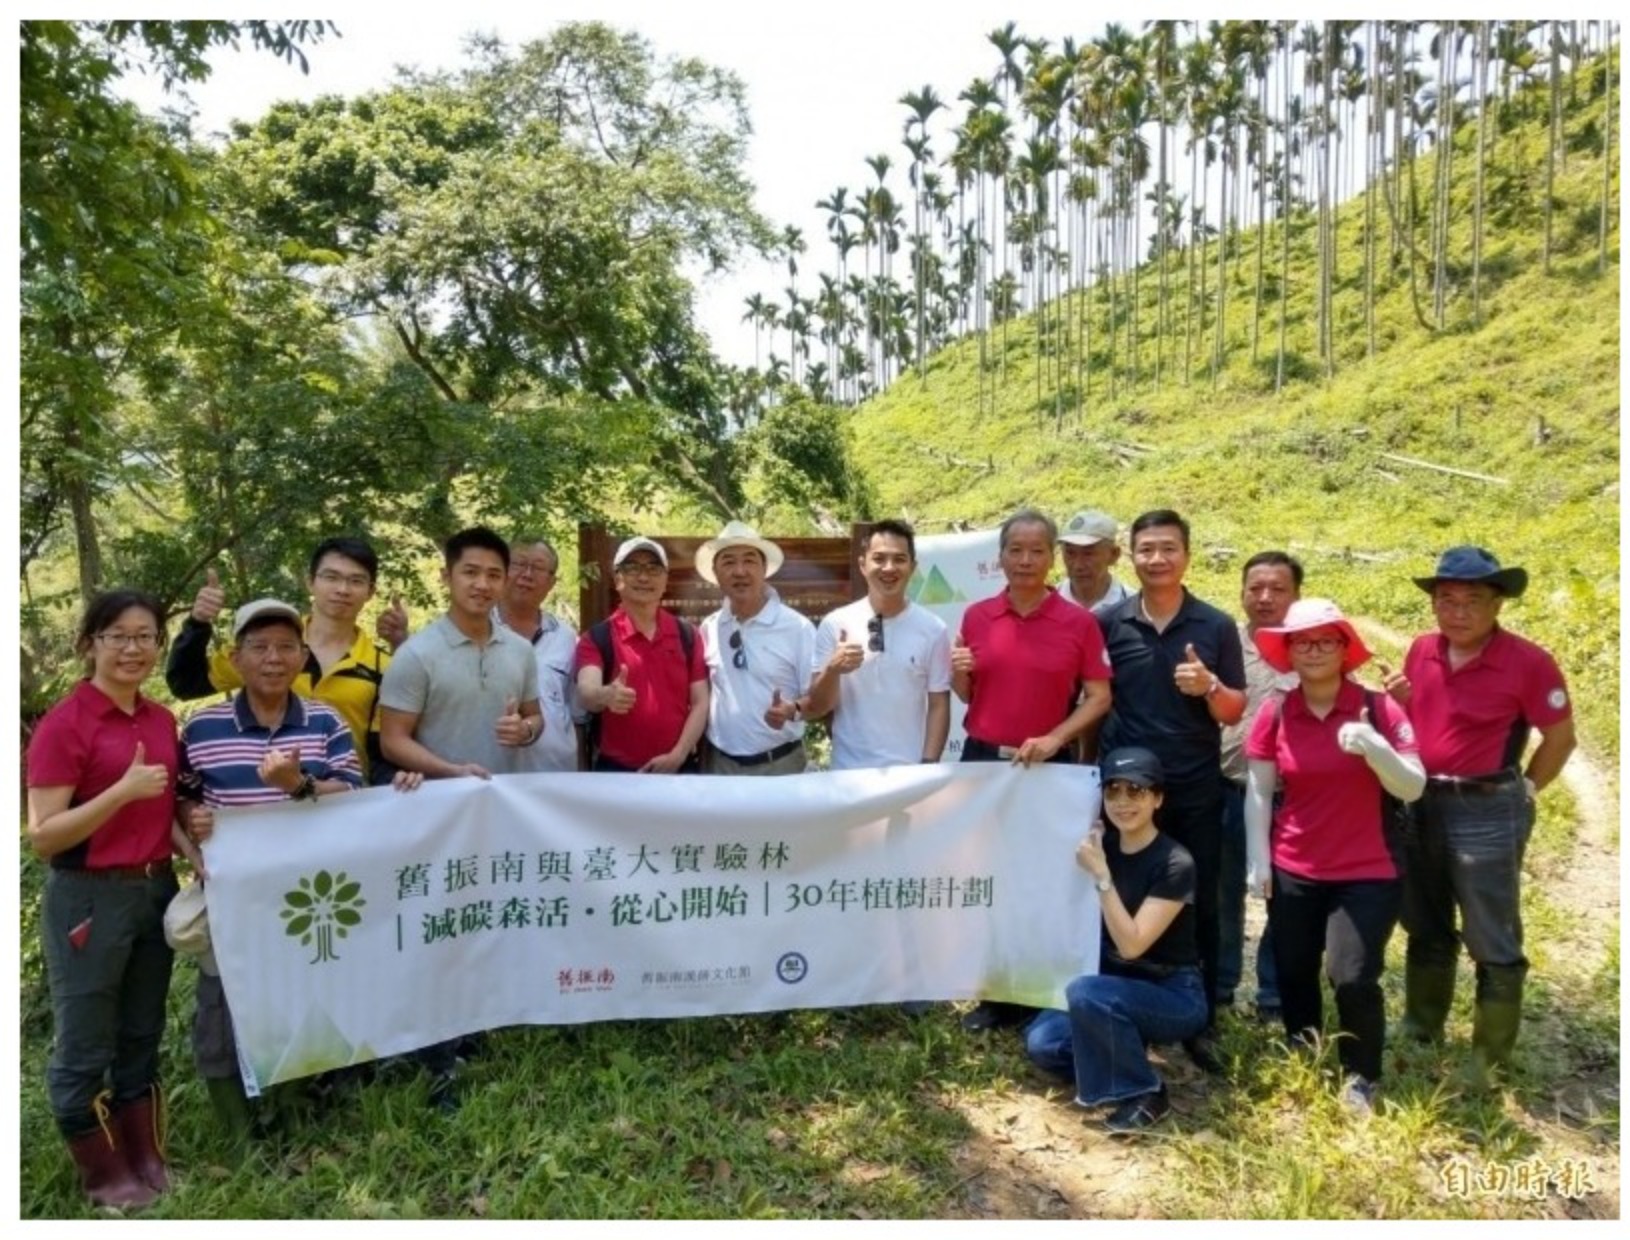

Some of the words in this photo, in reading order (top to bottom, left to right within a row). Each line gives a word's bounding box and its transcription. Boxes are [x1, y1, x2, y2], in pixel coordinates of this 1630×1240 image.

[395, 841, 790, 901] 舊振南與臺大實驗林
[785, 876, 994, 912] 30年植樹計劃
